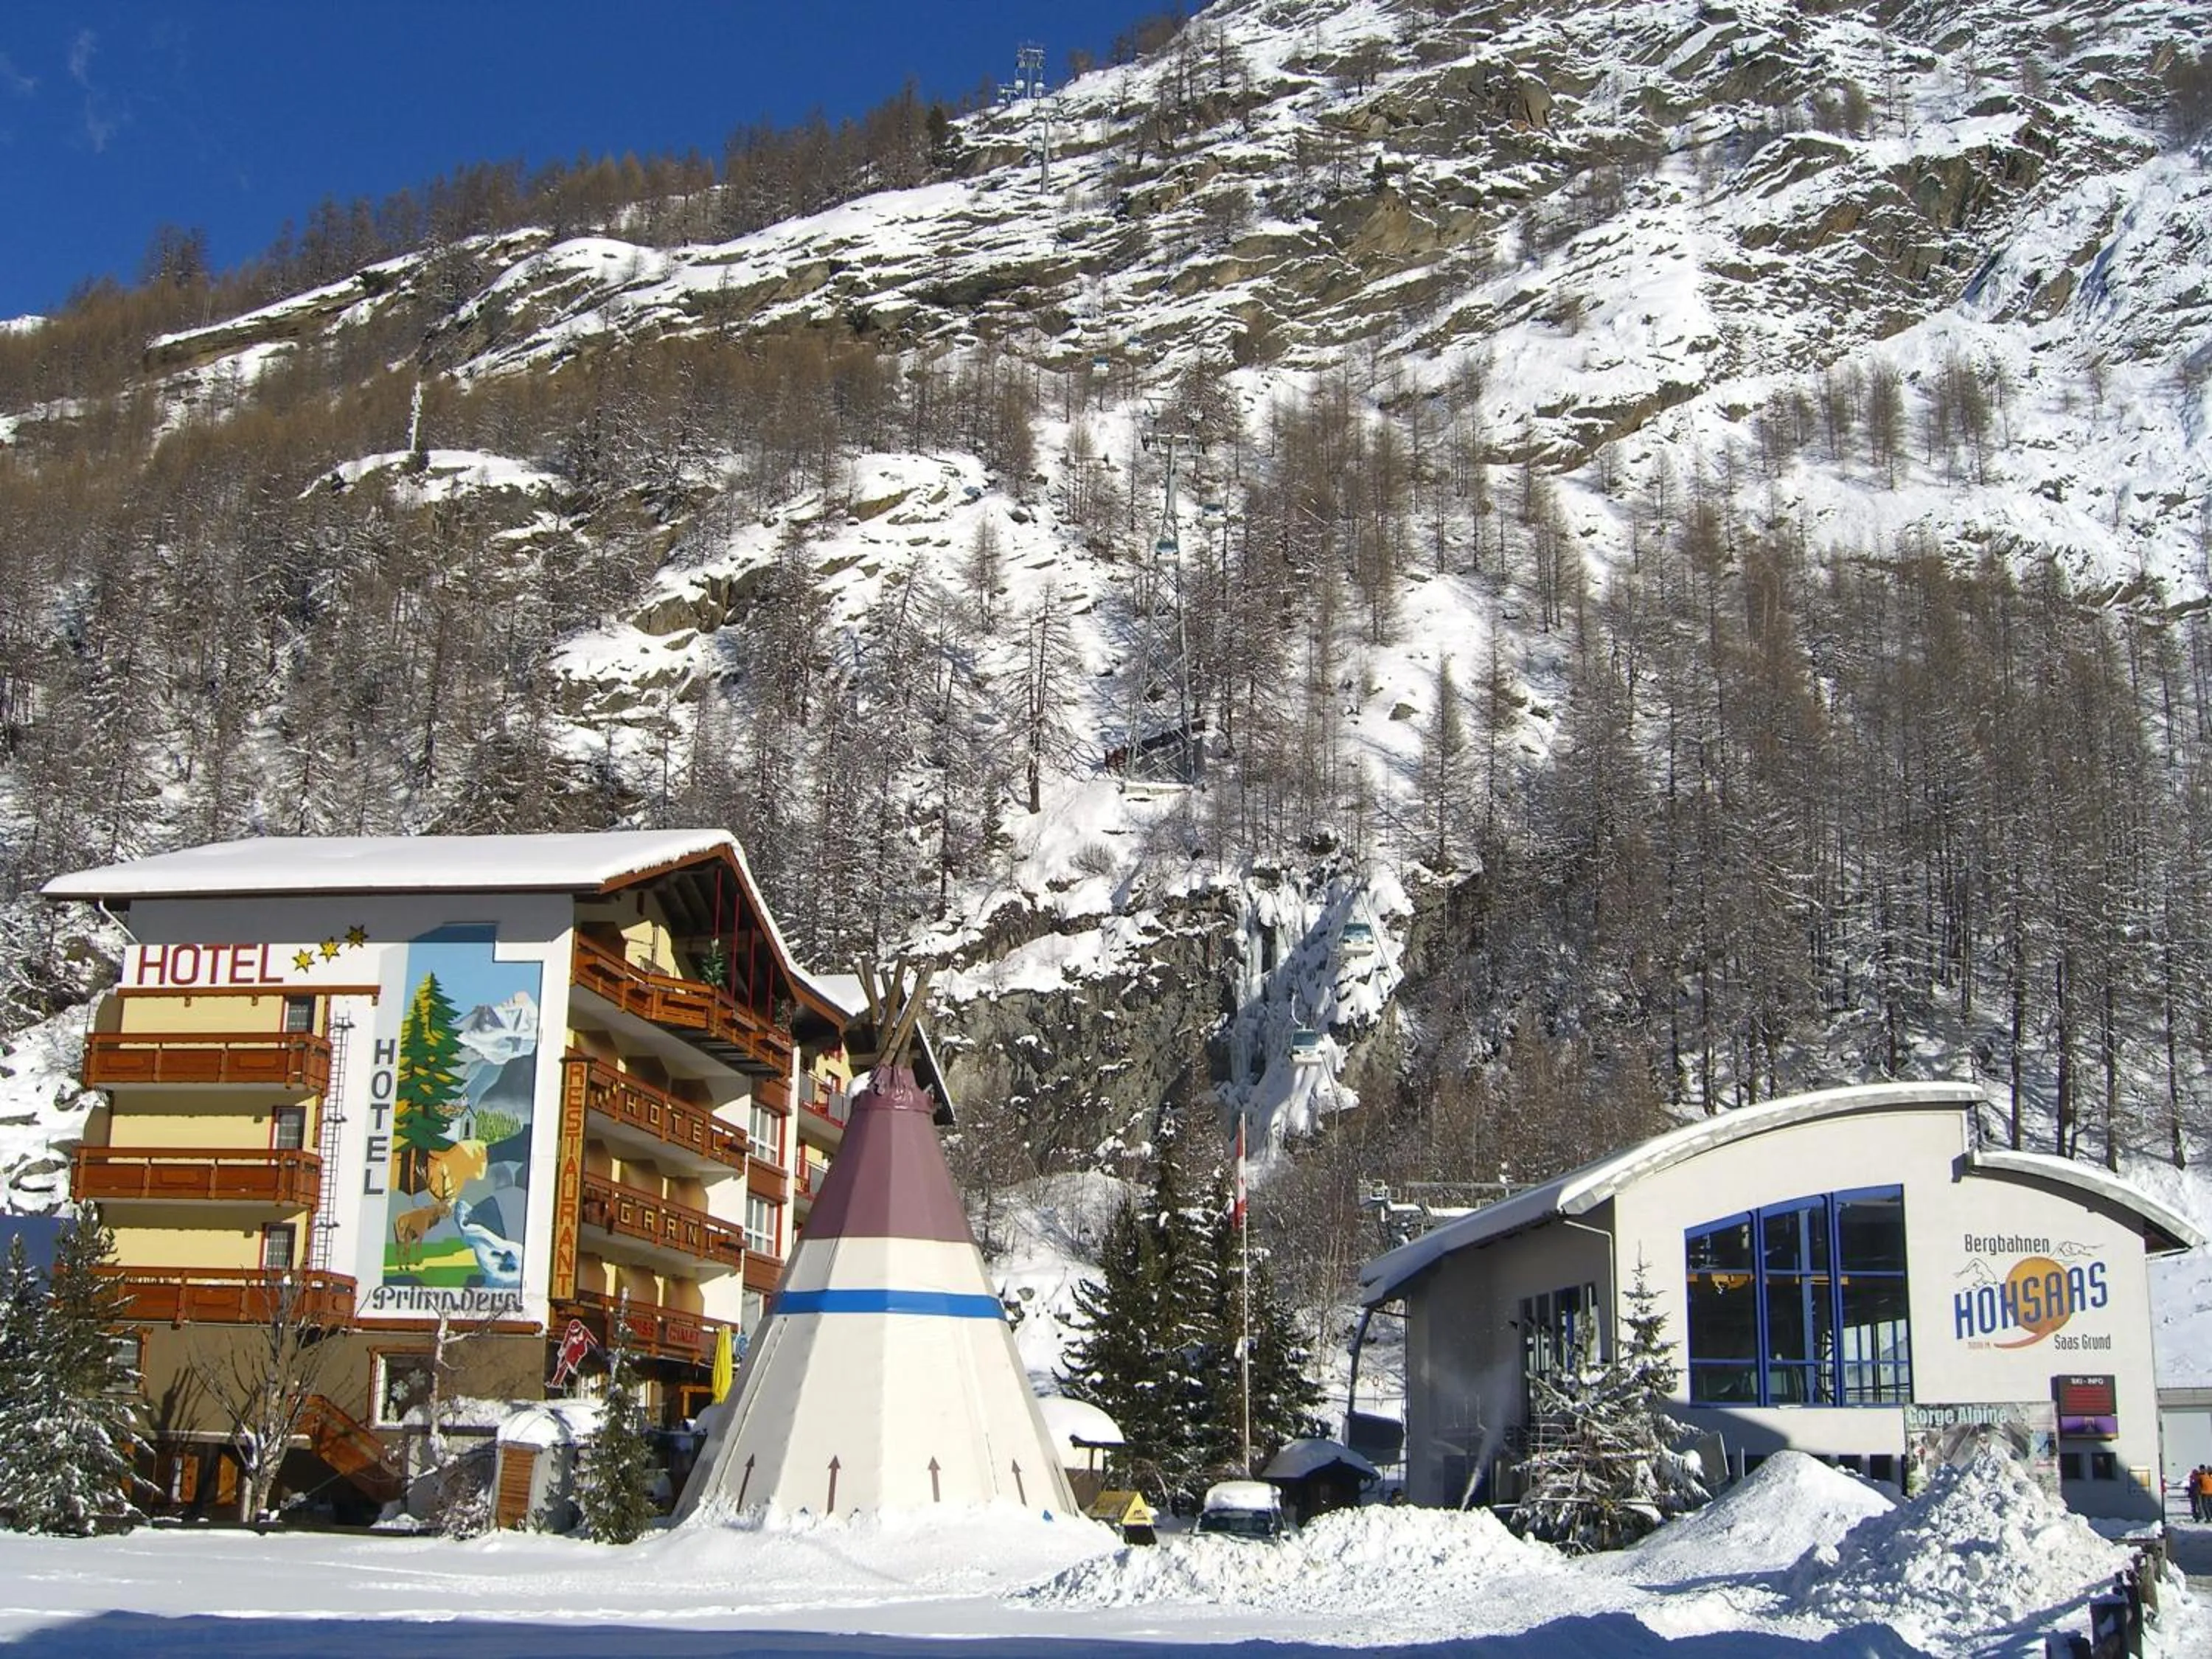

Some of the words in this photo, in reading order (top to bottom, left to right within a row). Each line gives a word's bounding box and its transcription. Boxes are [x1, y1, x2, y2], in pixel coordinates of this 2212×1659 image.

[136, 943, 284, 985] HOTEL
[364, 1038, 396, 1195] HOTEL
[625, 1096, 722, 1156] HOTEL
[557, 1064, 584, 1296] RESTAURANT
[620, 1202, 715, 1253] GARNI
[1964, 1234, 2051, 1255] Bergbahnen
[1954, 1261, 2109, 1340] HOHSAAS
[2053, 1334, 2079, 1351] Saas
[2081, 1334, 2111, 1351] Grund
[1907, 1406, 1954, 1426] Gorge
[1958, 1405, 2007, 1425] Alpine
